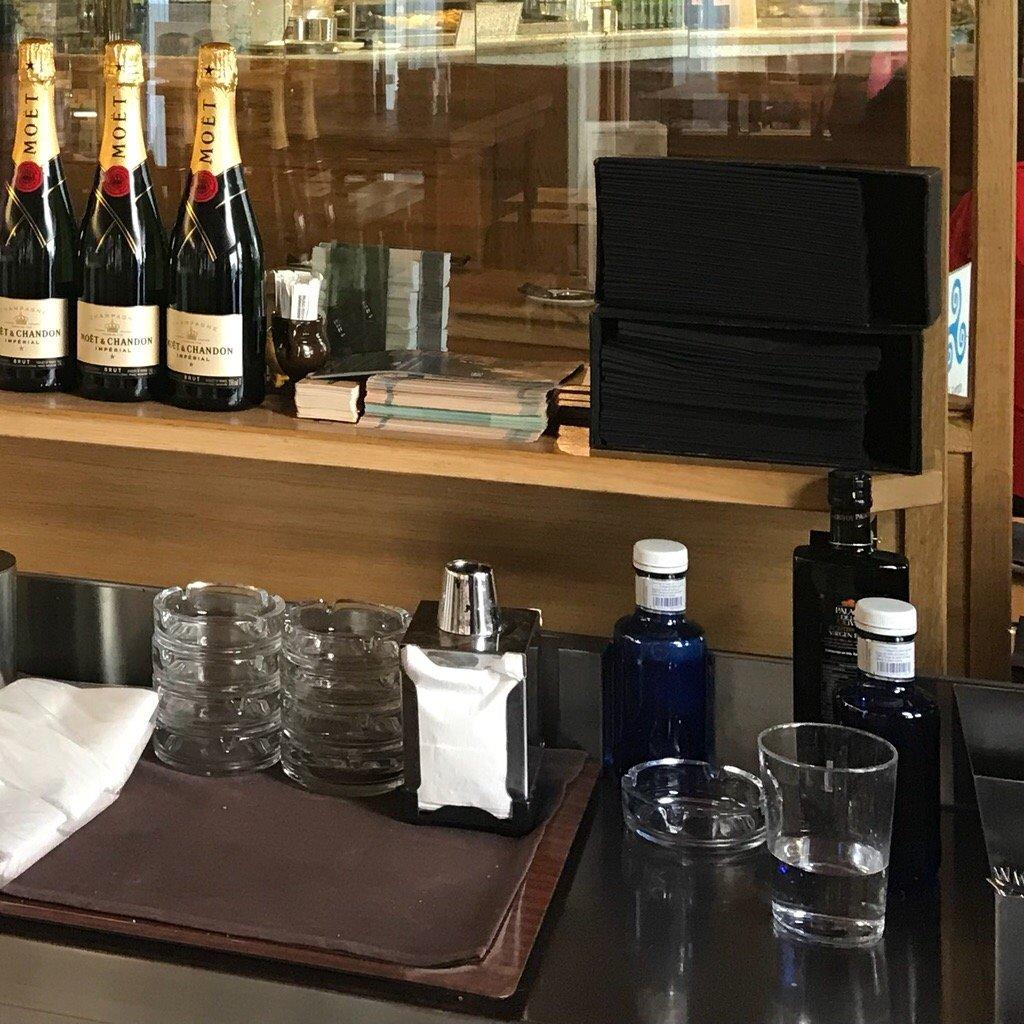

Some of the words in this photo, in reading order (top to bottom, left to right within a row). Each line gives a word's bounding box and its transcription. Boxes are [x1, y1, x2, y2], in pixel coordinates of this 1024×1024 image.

[16, 328, 61, 338] CHANDON
[107, 336, 153, 346] CHANDON
[186, 344, 233, 356] CHANDON
